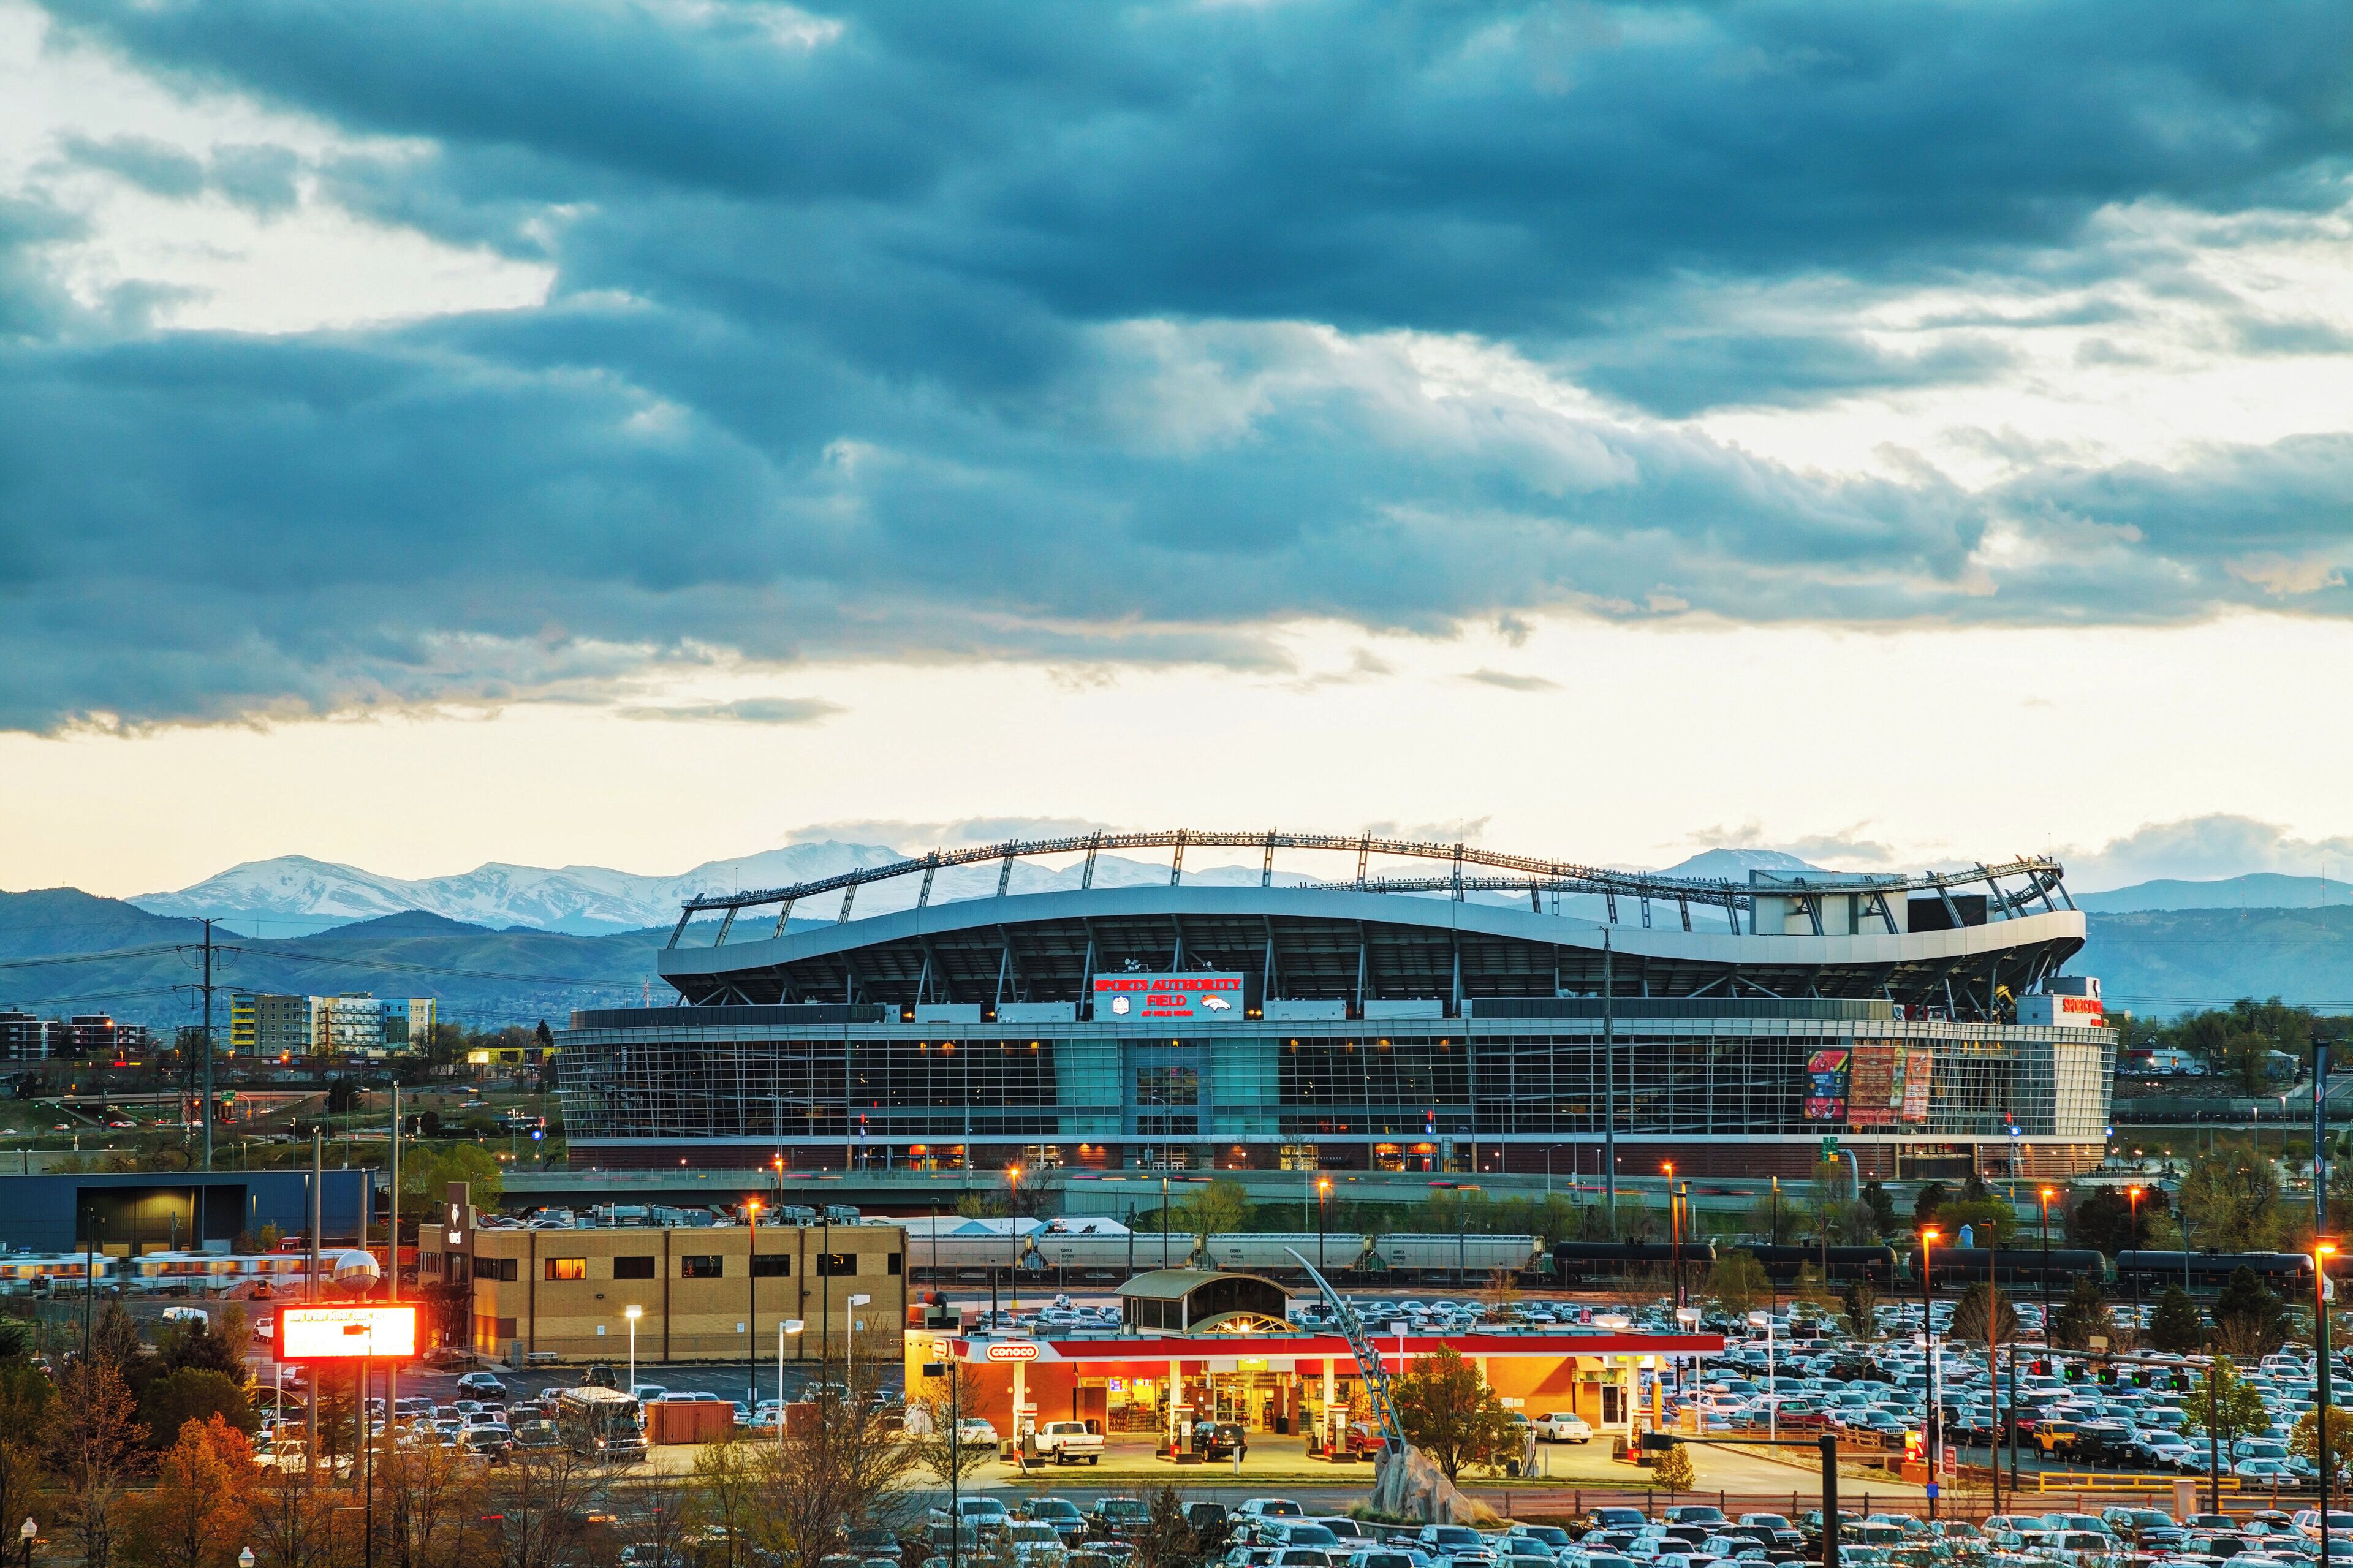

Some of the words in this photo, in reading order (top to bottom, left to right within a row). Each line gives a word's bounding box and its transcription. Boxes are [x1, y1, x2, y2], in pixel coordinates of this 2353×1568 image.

[1094, 979, 1148, 991] SPORTS
[1151, 979, 1241, 990] AUTHORITY
[1147, 994, 1187, 1006] FIELD
[2063, 998, 2089, 1013] SPORTS
